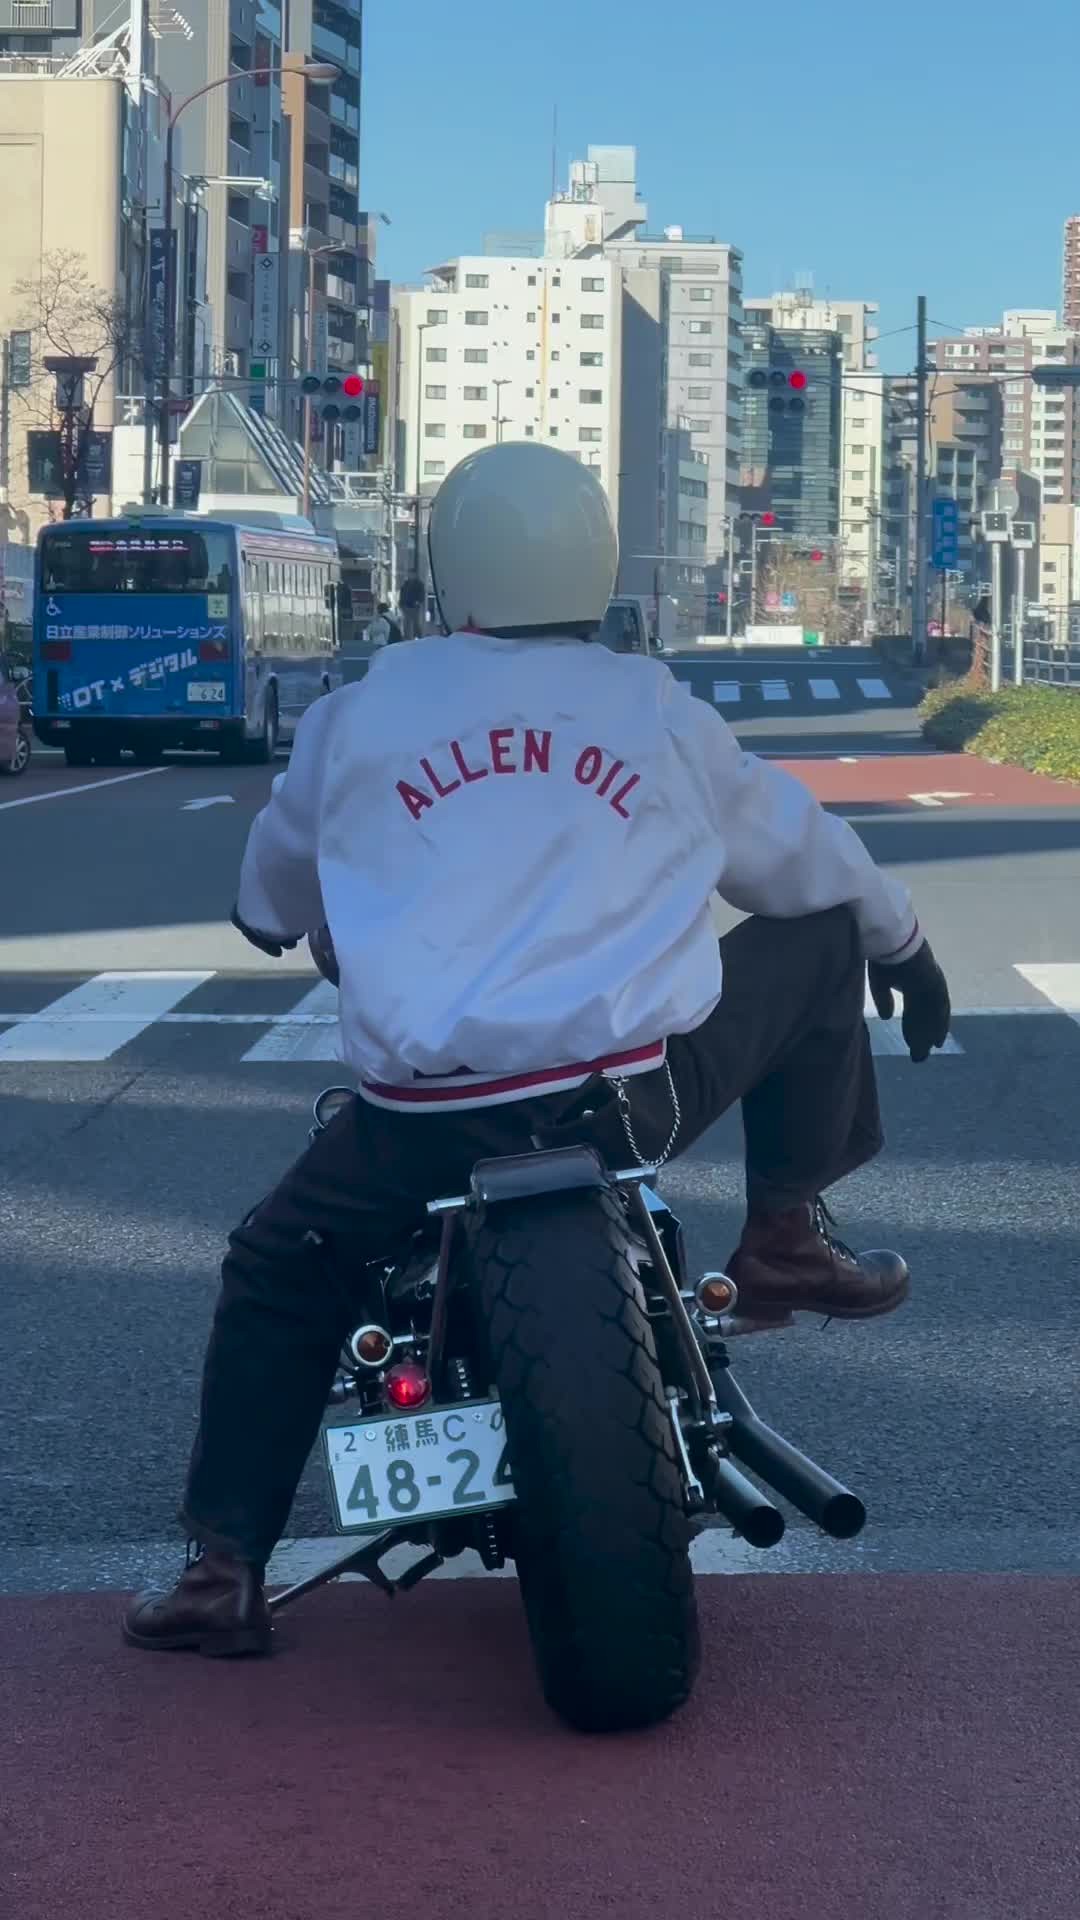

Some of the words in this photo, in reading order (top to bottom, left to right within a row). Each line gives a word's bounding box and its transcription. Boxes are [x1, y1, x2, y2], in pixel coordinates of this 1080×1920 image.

[128, 647, 198, 687] デジタル
[395, 727, 552, 821] ALLEN
[574, 745, 641, 820] OIL
[343, 1431, 357, 1453] 2
